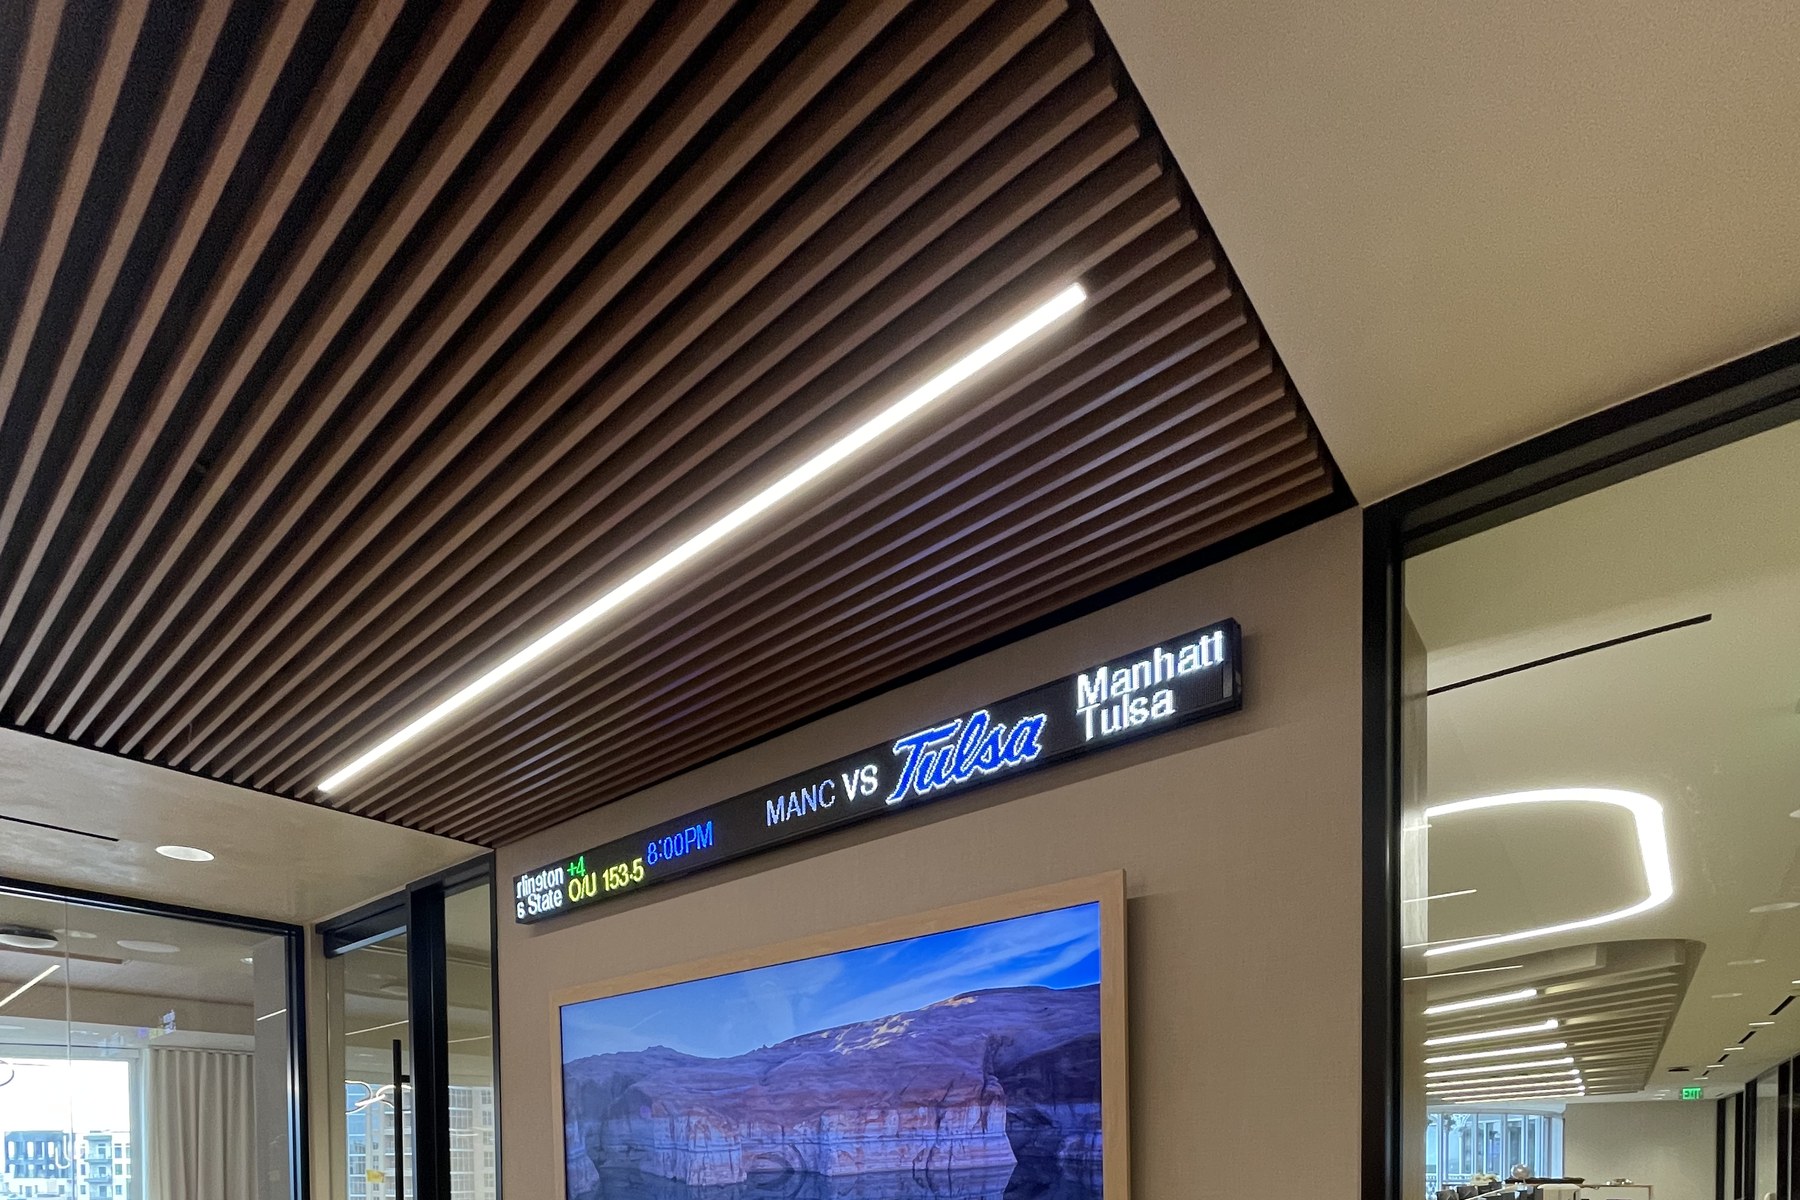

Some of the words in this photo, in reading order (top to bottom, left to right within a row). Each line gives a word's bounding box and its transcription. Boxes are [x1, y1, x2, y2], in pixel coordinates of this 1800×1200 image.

[1077, 630, 1225, 708] Manhatt
[1076, 688, 1177, 742] Tulsa
[766, 779, 836, 827] MANC
[841, 764, 879, 802] VS
[885, 709, 1048, 805] Tulsa
[646, 821, 713, 865] 8:00PM
[516, 867, 564, 898] rlington
[566, 855, 586, 877] +4
[527, 889, 563, 915] State
[568, 872, 598, 902] O/U
[602, 857, 645, 891] 153.5
[1682, 1087, 1701, 1100] EXIT
